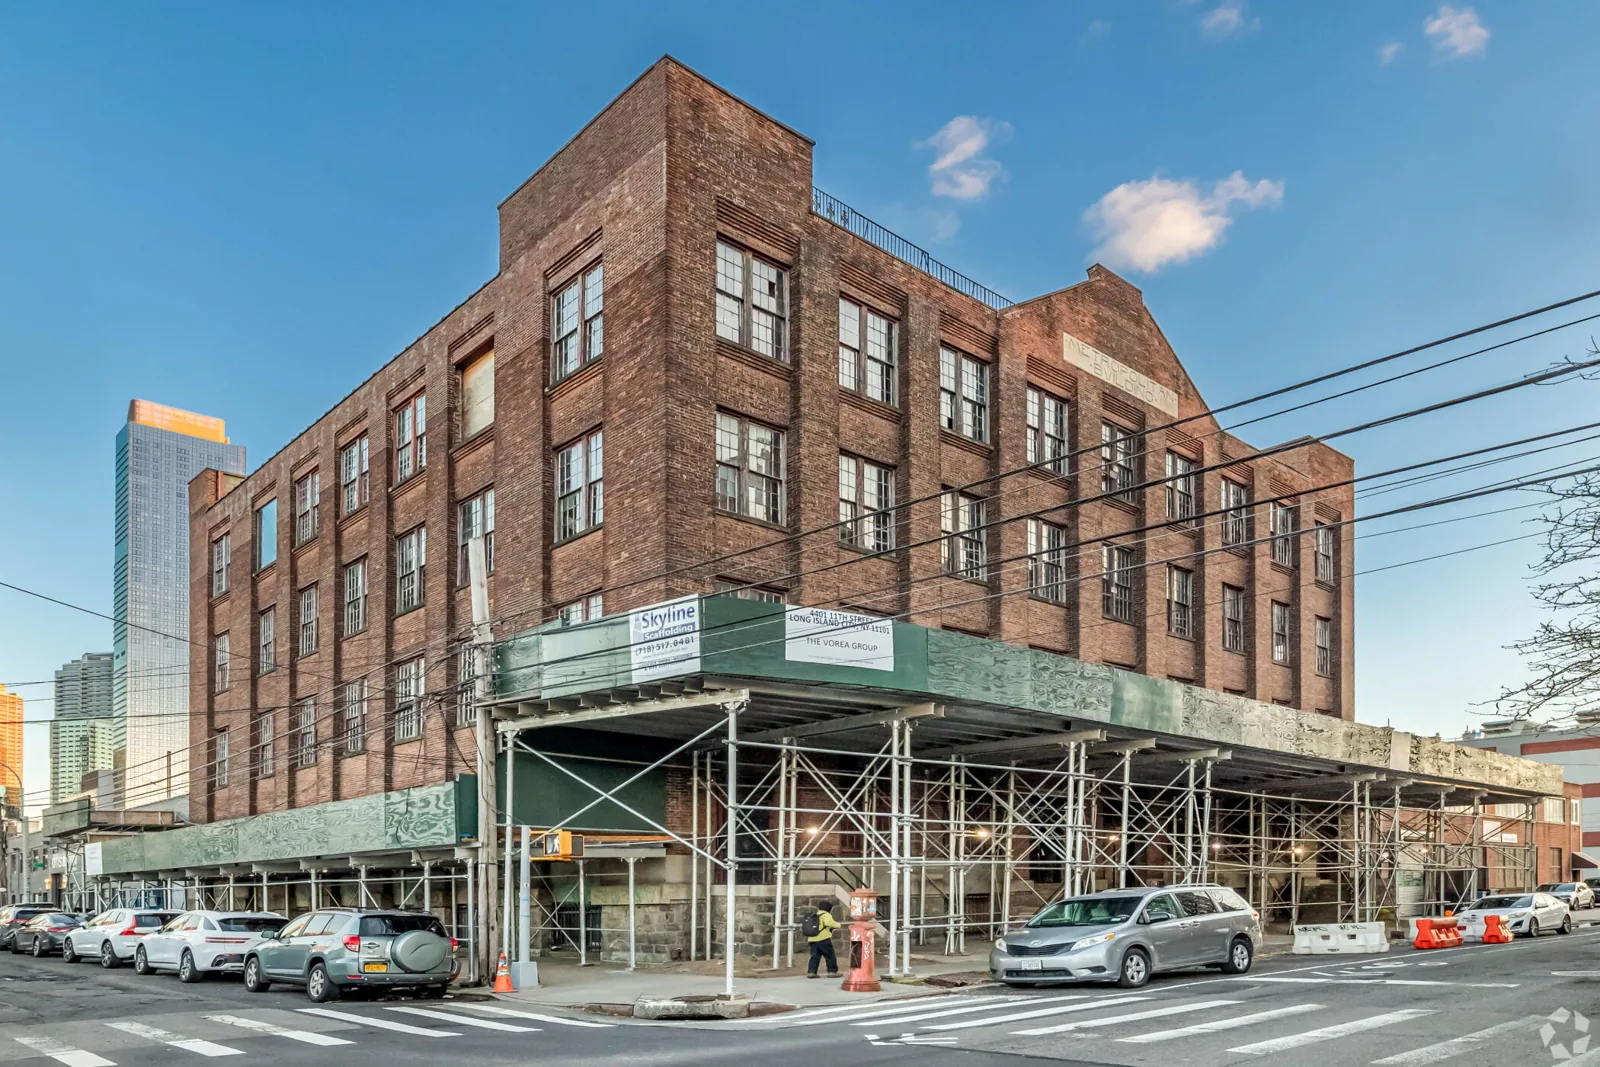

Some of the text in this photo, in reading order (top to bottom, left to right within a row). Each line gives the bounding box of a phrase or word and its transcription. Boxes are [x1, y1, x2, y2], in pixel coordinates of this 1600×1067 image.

[1068, 338, 1174, 402] METROPOLITAN
[641, 605, 695, 630] Skyline
[789, 614, 811, 624] LONG
[812, 617, 840, 627] ISLAND
[871, 625, 890, 634] 11101
[810, 609, 873, 625] 4401 11TH STREET
[644, 624, 693, 640] Scaffolding
[806, 637, 878, 652] THE VOREA GROUP
